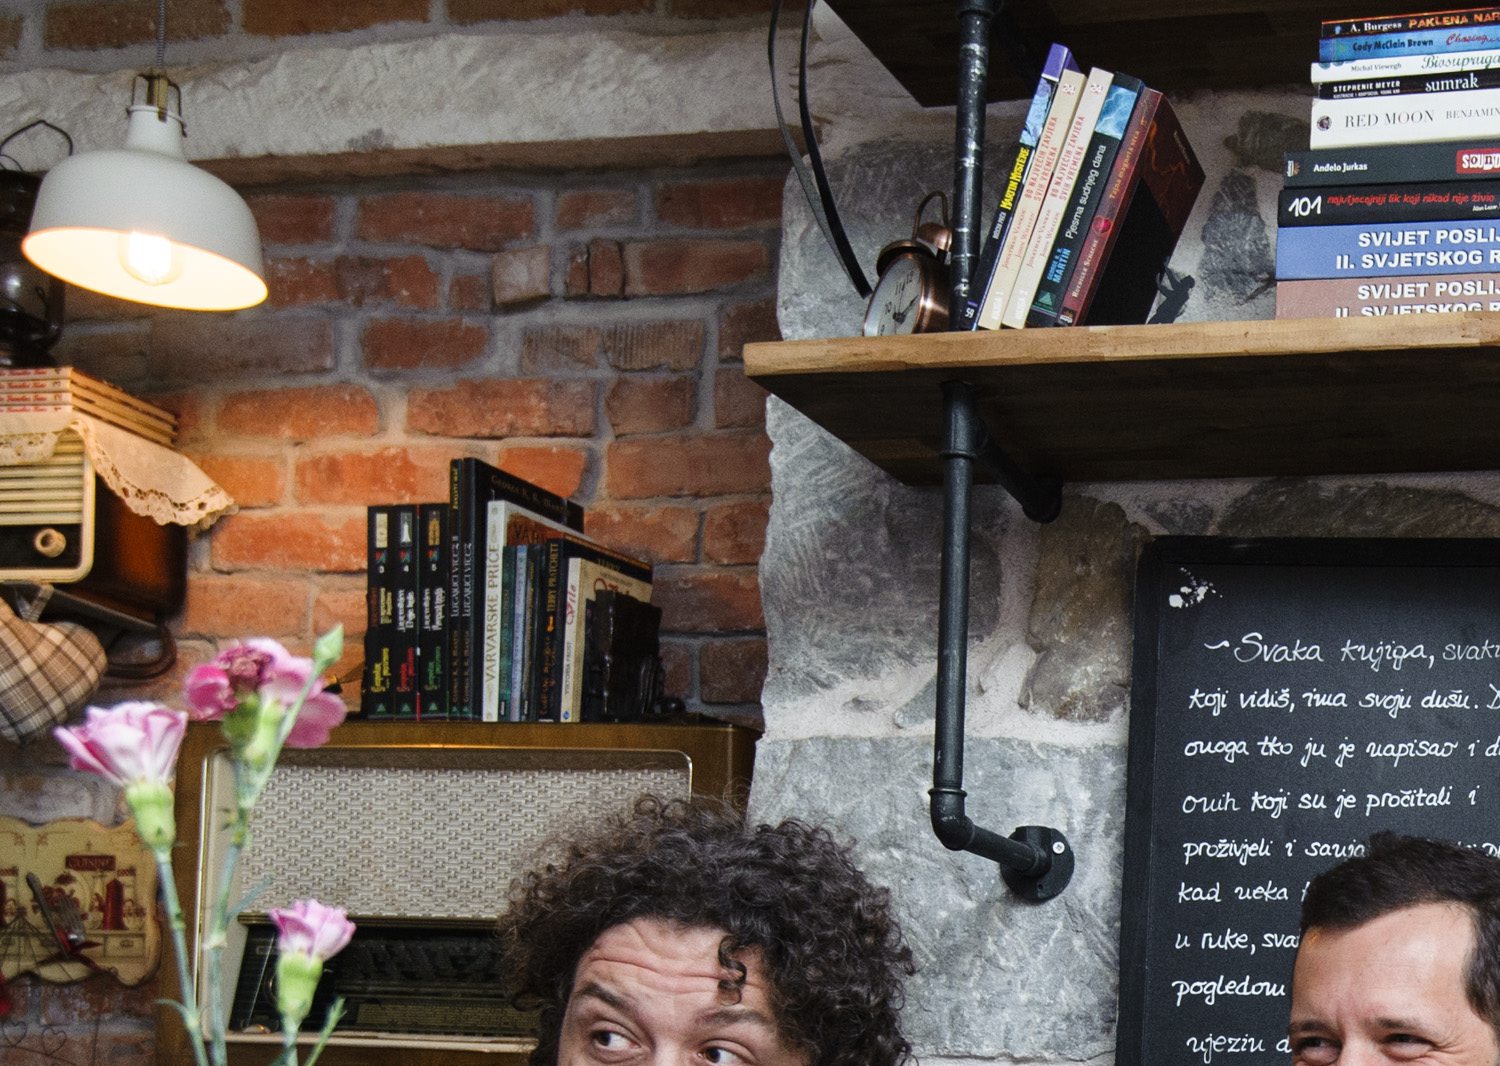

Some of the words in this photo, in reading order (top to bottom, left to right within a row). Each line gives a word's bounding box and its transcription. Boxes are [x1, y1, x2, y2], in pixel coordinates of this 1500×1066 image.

[1364, 21, 1403, 32] Burgess
[1409, 14, 1469, 28] PAKLENA
[1353, 41, 1372, 51] Cody
[1374, 39, 1406, 50] McClain
[1407, 38, 1434, 47] Brown
[1351, 63, 1374, 73] Michal
[1421, 54, 1500, 71] Biosupruga
[1333, 82, 1374, 93] STEPHENIE
[1375, 80, 1401, 90] MEYER
[1425, 73, 1480, 91] sumrak
[1345, 113, 1379, 128] RED
[1384, 109, 1435, 125] MOON
[1039, 147, 1058, 183] VREMENA
[1065, 146, 1084, 183] VREMENA
[1342, 162, 1368, 172] Jurkas
[1000, 180, 1018, 210] MARTIN
[1065, 205, 1084, 239] Pjesma
[1079, 171, 1100, 206] sudnjeg
[1092, 144, 1107, 169] dana
[1402, 194, 1422, 205] koji
[1288, 196, 1322, 216] 101
[1358, 230, 1430, 247] SVIJET
[1053, 248, 1071, 283] MARTIN
[1336, 255, 1355, 269] II.
[1361, 251, 1484, 269] SVJETSKOG
[1357, 283, 1430, 300] SVIJET
[487, 543, 500, 592] PRIČE
[485, 594, 498, 682] VARVARSKE
[1233, 632, 1324, 664] Svaka
[1442, 639, 1500, 662] svaki
[1188, 689, 1229, 716] koji
[1240, 687, 1294, 714] vidiš,
[1302, 688, 1348, 708] ima
[1358, 691, 1412, 719] svoju
[1421, 690, 1478, 711] dušu.
[1184, 739, 1250, 763] onoga
[1257, 736, 1293, 756] tko
[1301, 737, 1326, 768] ju
[1334, 739, 1355, 769] je
[1366, 739, 1458, 768] napisao
[1467, 739, 1476, 758] i
[1181, 792, 1242, 814] onih
[1251, 788, 1289, 819] koji
[1298, 792, 1327, 811] su
[1334, 790, 1356, 818] je
[1366, 785, 1453, 817] pročitali
[1468, 784, 1481, 806] i
[1183, 839, 1272, 866] proživjeli
[1285, 838, 1297, 858] i
[1178, 881, 1222, 903] kad
[1234, 880, 1289, 902] neka
[1175, 932, 1191, 949] u
[1201, 928, 1256, 955] ruke,
[1171, 975, 1286, 1006] pogledom
